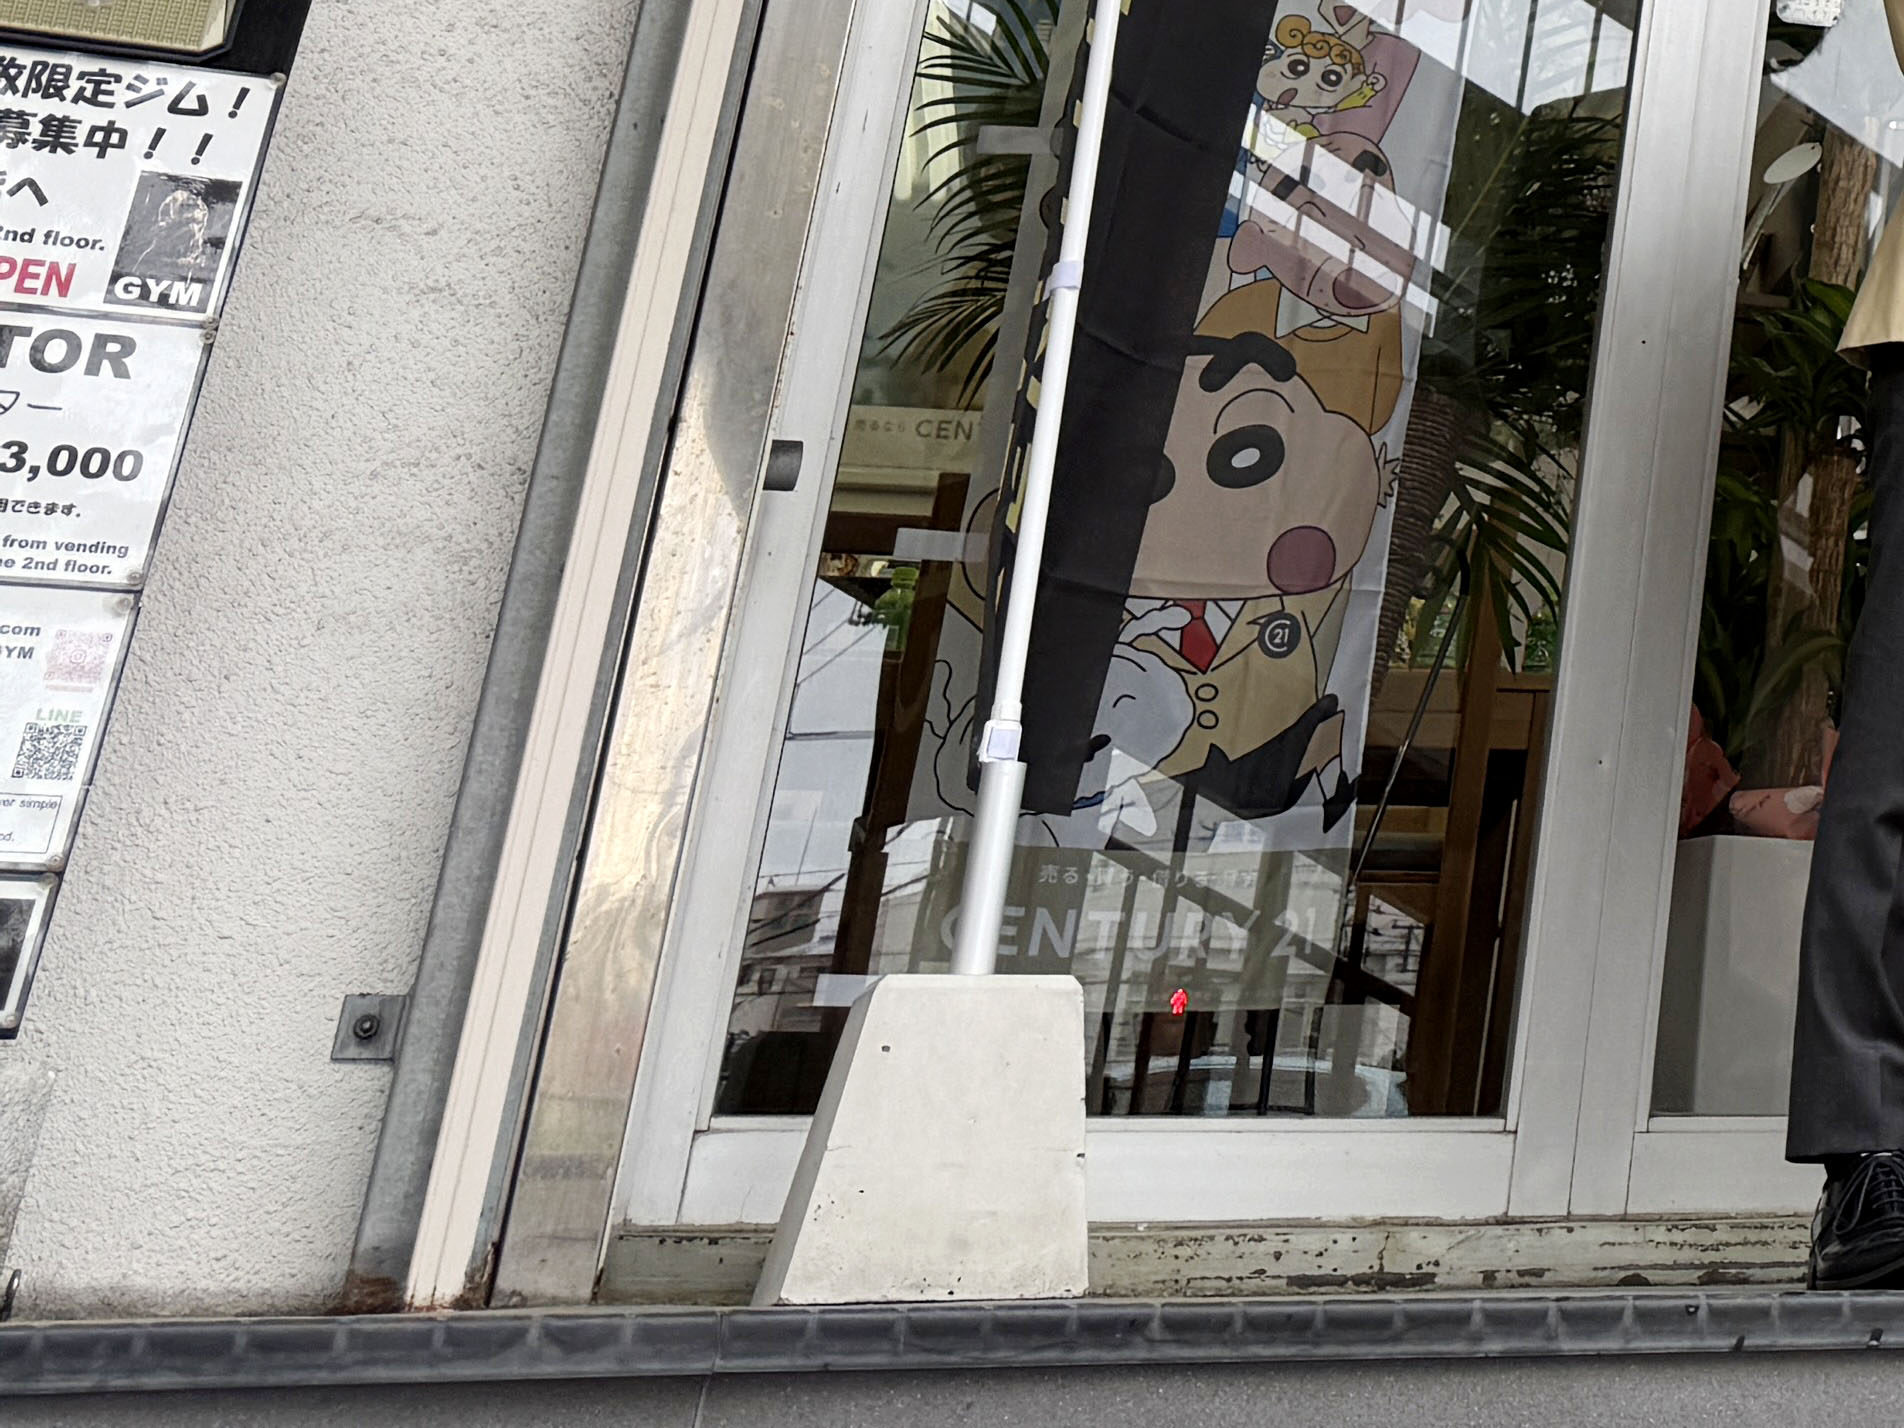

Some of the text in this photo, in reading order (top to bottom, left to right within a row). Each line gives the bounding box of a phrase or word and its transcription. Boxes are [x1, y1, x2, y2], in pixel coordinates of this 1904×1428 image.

[0, 227, 106, 252] nd floor.
[113, 275, 204, 308] GYM
[914, 418, 982, 442] CEN
[54, 539, 130, 560] vending
[21, 556, 59, 573] 2nd
[63, 558, 113, 576] floor.
[0, 645, 36, 661] YM
[35, 707, 84, 725] LINE
